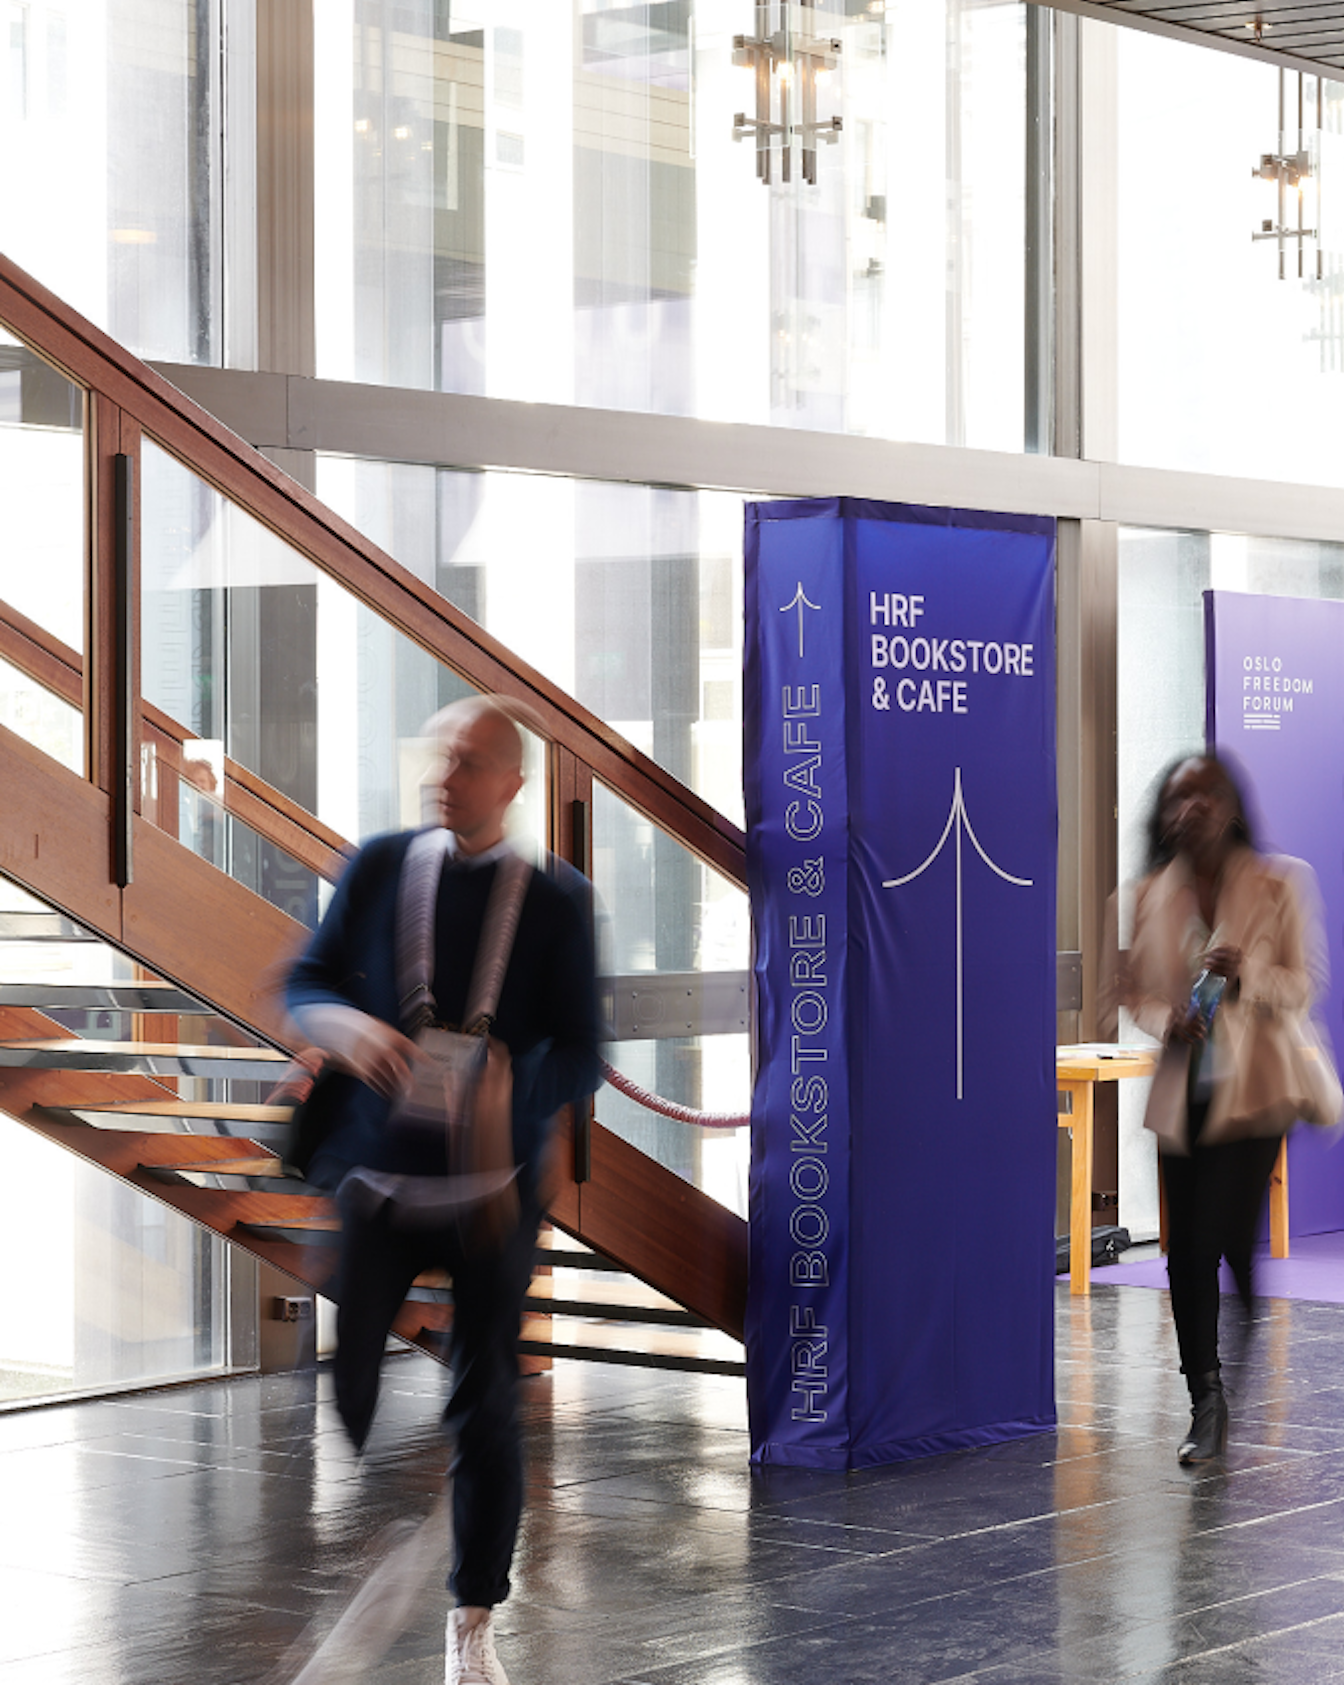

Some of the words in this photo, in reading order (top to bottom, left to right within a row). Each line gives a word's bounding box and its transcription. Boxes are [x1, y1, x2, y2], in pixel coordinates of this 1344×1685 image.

[870, 591, 925, 628] HRF
[871, 635, 1034, 676] BOOKSTORE
[1243, 656, 1282, 672] OSLO
[872, 676, 890, 710] &
[897, 678, 968, 713] CAFE
[1243, 676, 1313, 694] FREEDOM
[1243, 696, 1293, 712] FORUM
[782, 683, 824, 841] CAFE
[787, 856, 826, 897] &
[789, 914, 829, 1287] BOOKSTORE
[789, 1305, 828, 1423] HRF
